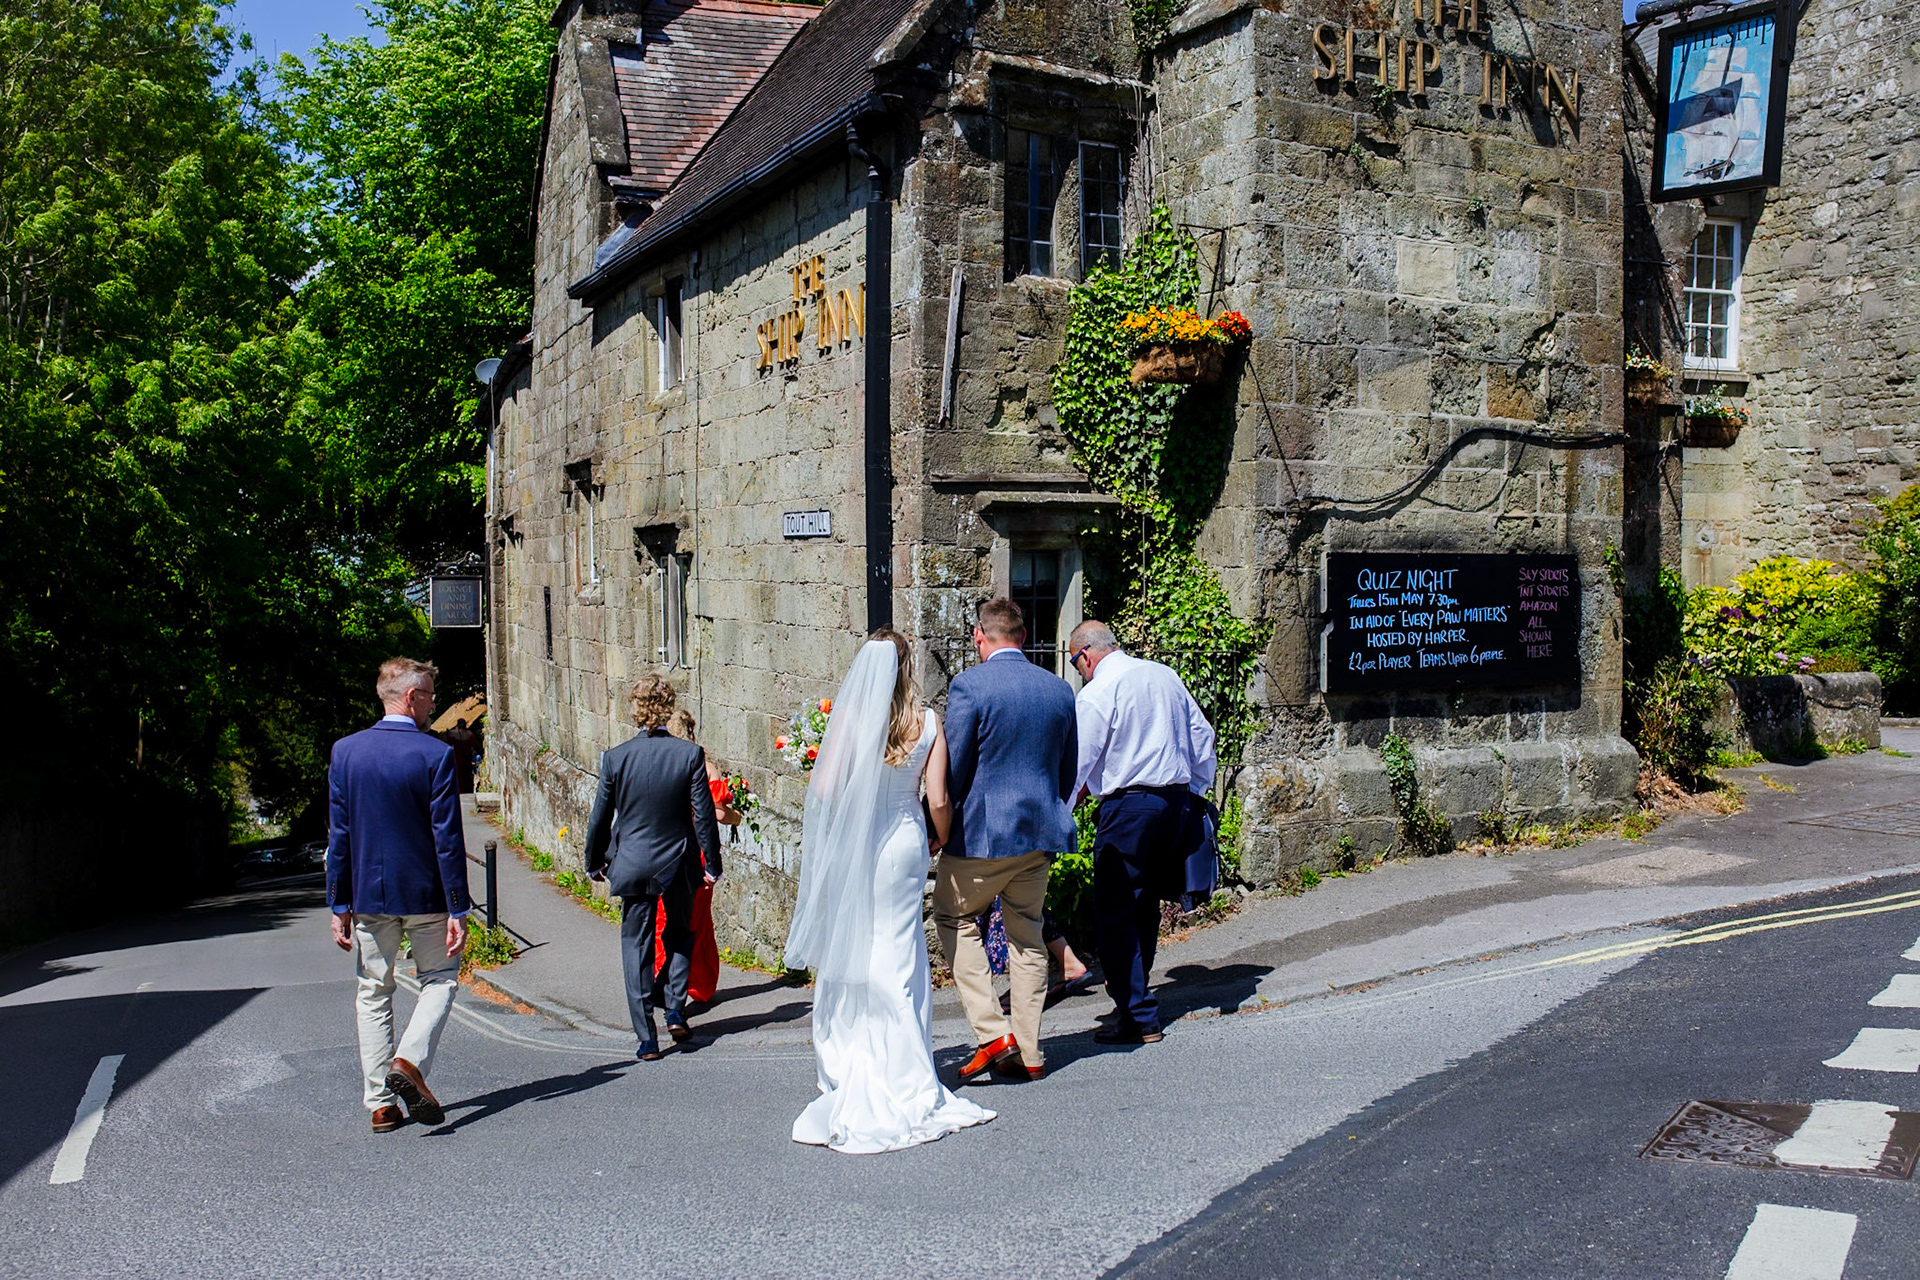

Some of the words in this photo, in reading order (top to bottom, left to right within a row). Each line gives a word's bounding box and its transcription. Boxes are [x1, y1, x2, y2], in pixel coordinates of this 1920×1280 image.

[1676, 27, 1718, 64] THE
[1724, 15, 1776, 46] SHIP
[1313, 23, 1441, 97] SHIP
[1479, 52, 1579, 119] INN
[788, 252, 826, 304] THE
[756, 308, 805, 370] SHIP
[816, 282, 865, 350] INN
[786, 515, 805, 533] TOUT
[807, 514, 826, 532] HILL
[1357, 568, 1402, 591] QUIZ
[1406, 568, 1459, 592] NIGHT
[1519, 567, 1538, 582] SKY
[1539, 568, 1569, 583] SPORTS
[1401, 591, 1424, 606] MAY
[1517, 584, 1535, 598] TNT
[1537, 584, 1570, 597] SPORTS
[440, 602, 471, 610] DINING
[1519, 600, 1558, 612] AMAZON
[1349, 615, 1364, 630] IN
[1436, 609, 1462, 626] PAW
[1527, 615, 1548, 629] ALL
[1367, 632, 1406, 648] HOSTED
[1407, 631, 1423, 647] BY
[1519, 629, 1552, 643] SHOWN
[1378, 652, 1412, 670] PLAYER
[1416, 647, 1447, 669] TEAMS
[1470, 644, 1480, 664] 6
[1526, 643, 1553, 659] HERE
